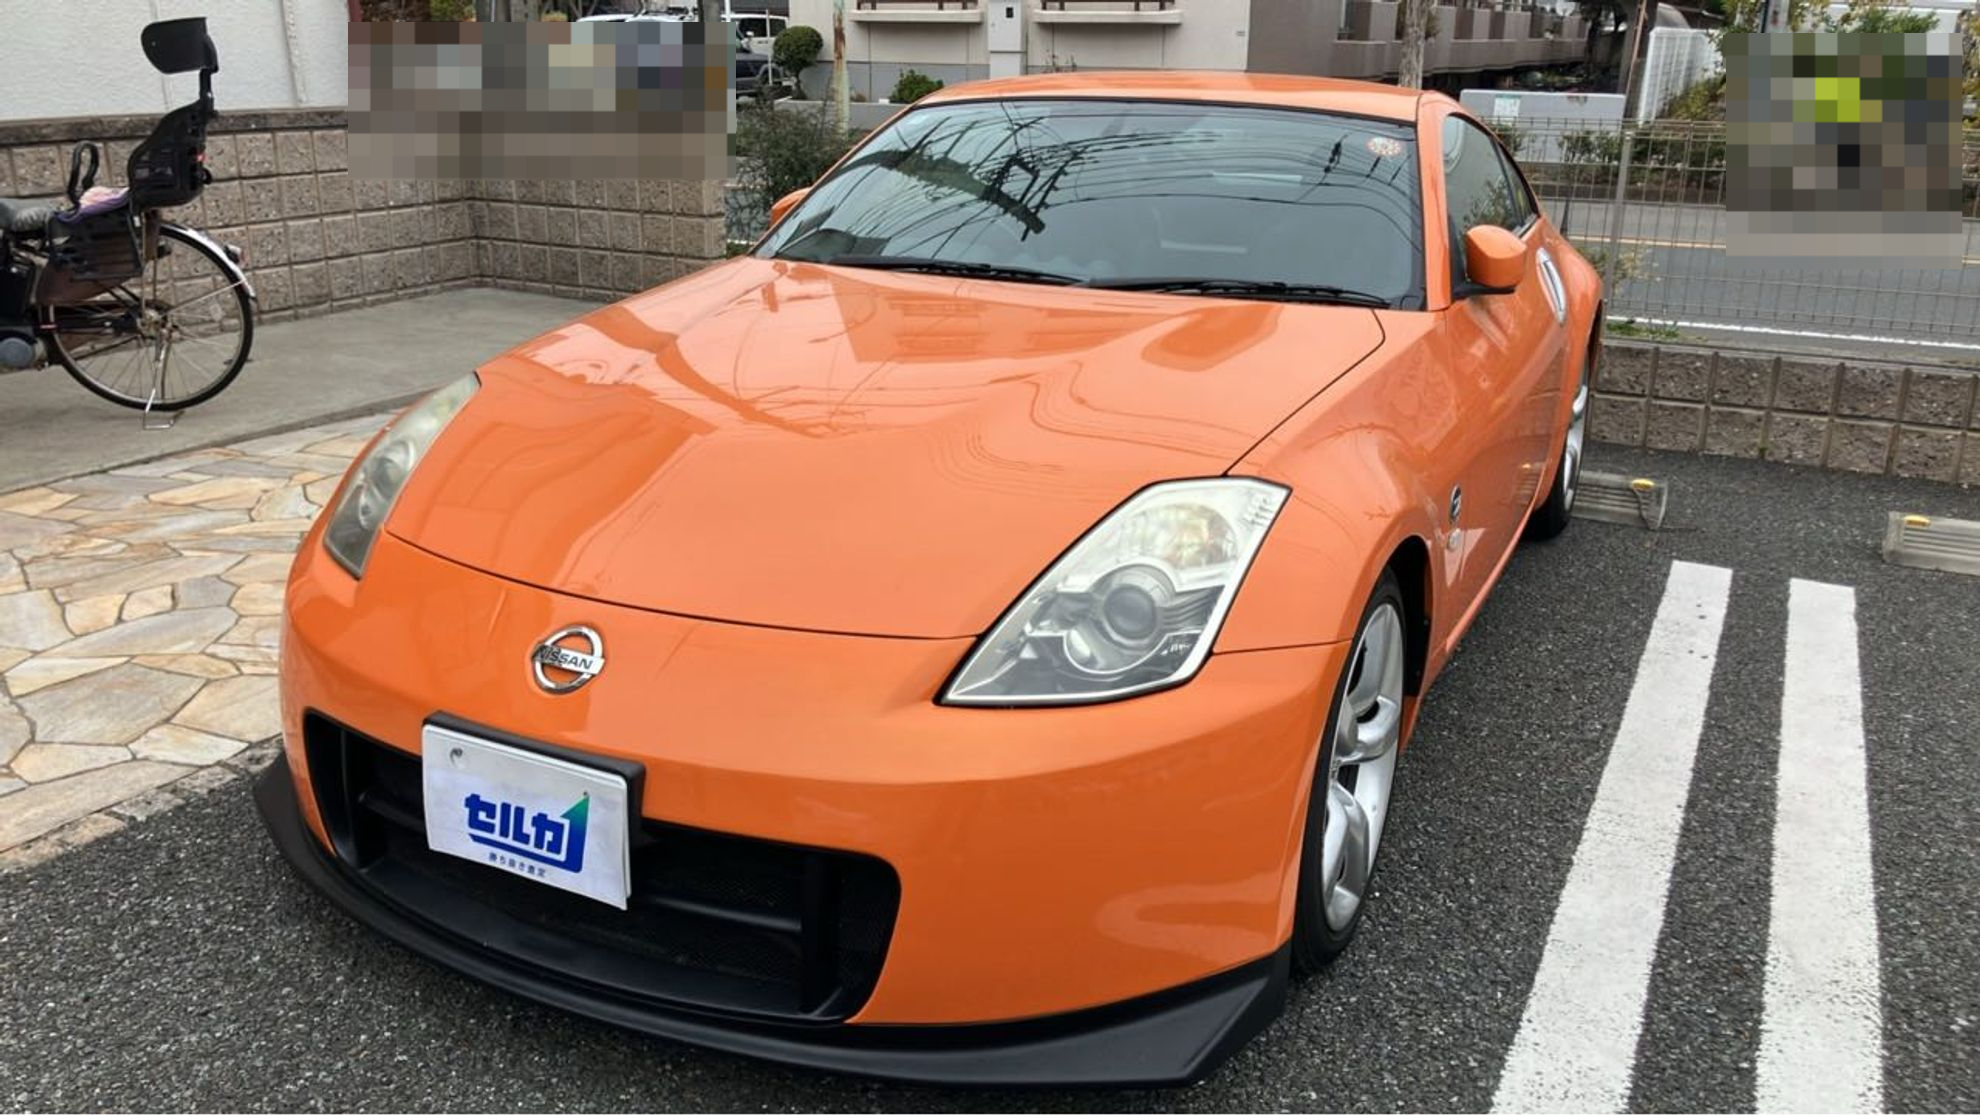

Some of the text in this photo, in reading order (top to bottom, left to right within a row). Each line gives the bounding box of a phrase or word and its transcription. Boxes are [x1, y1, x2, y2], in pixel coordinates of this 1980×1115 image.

[538, 645, 593, 670] NISSAN
[465, 793, 564, 856] セルカ
